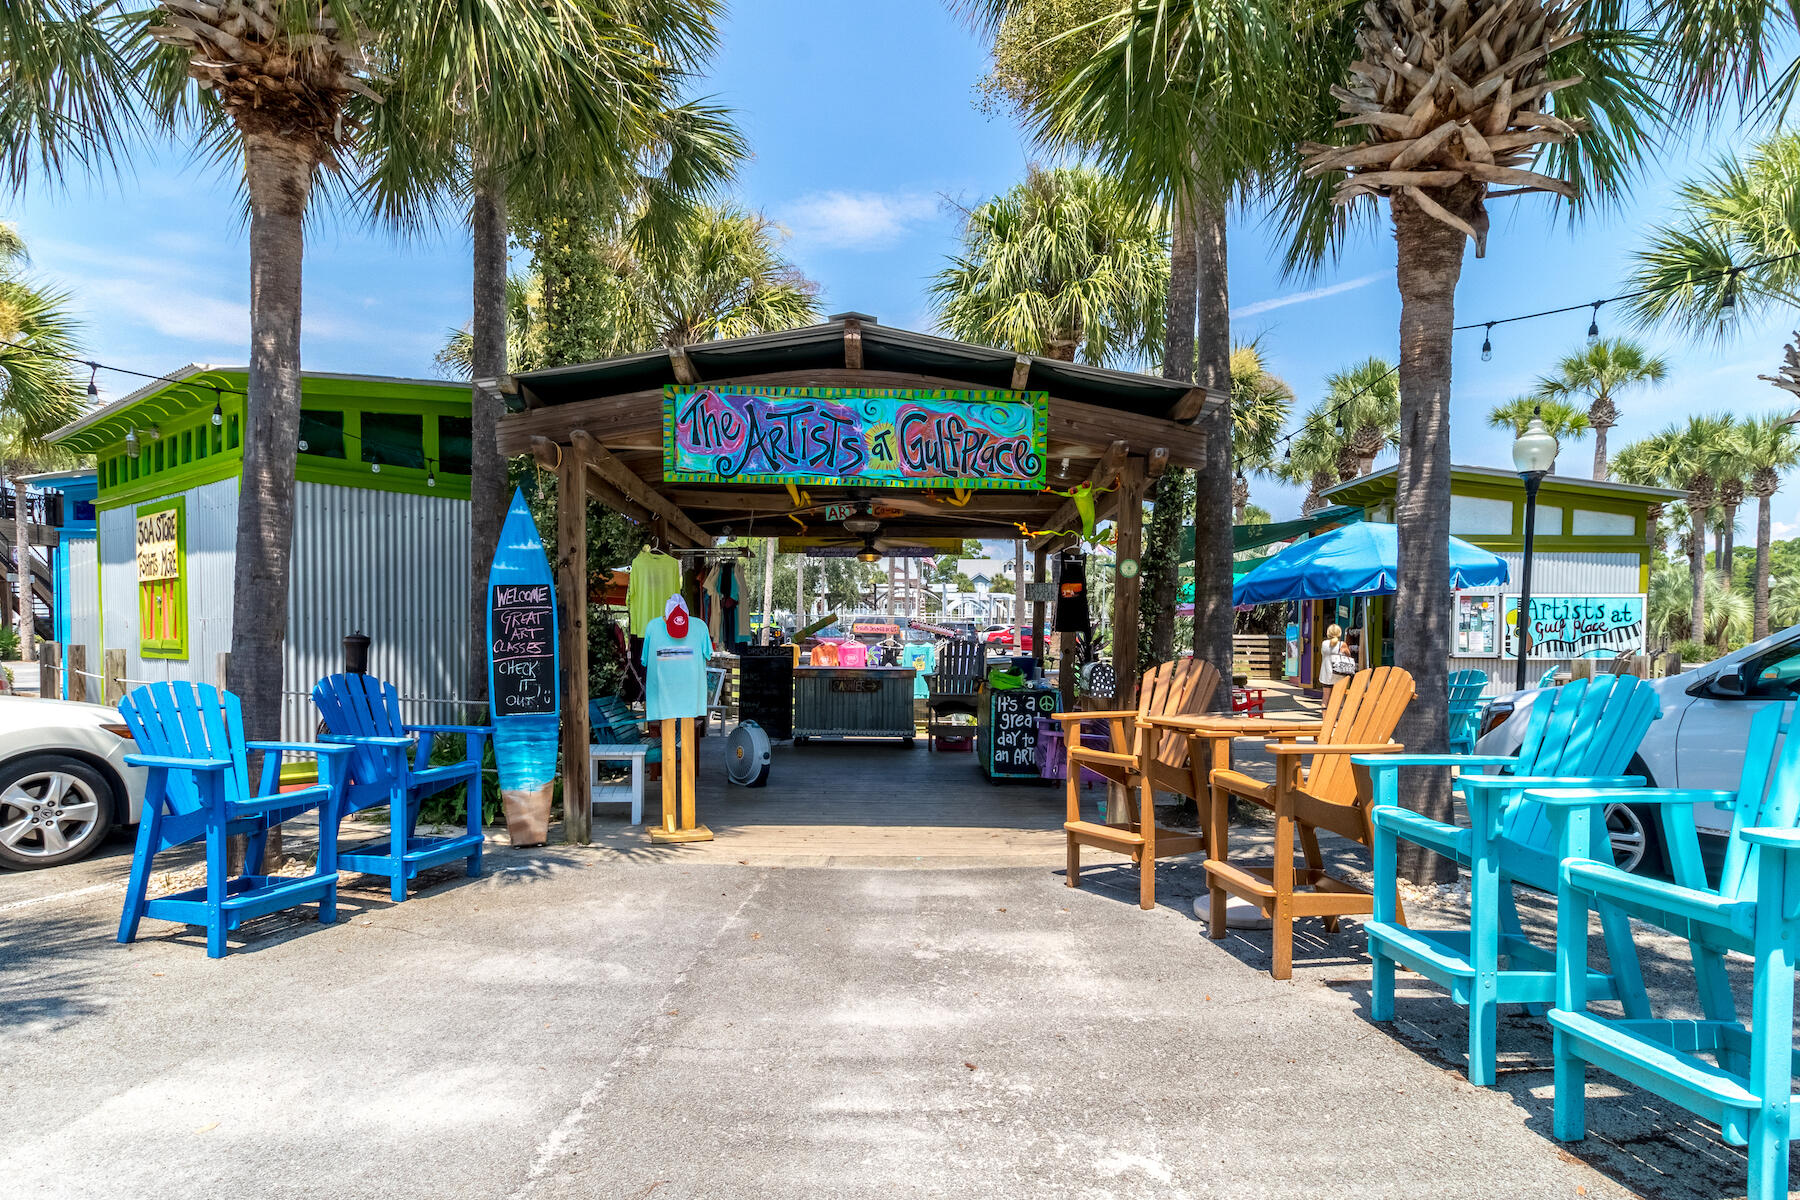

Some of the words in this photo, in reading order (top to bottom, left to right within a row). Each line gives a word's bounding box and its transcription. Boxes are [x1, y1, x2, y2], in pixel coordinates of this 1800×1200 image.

[680, 393, 741, 448] The
[138, 517, 155, 547] 30A
[496, 586, 549, 608] WELCOME
[1529, 598, 1605, 620] Artists
[1611, 602, 1633, 623] at
[500, 610, 550, 635] GREAT
[511, 627, 545, 641] ART
[493, 639, 546, 654] CLASSES
[498, 660, 539, 679] CHECK
[518, 679, 537, 693] IT
[997, 695, 1018, 713] It's
[1025, 696, 1036, 712] a
[999, 711, 1041, 730] great
[1022, 732, 1035, 747] to
[995, 749, 1009, 763] an
